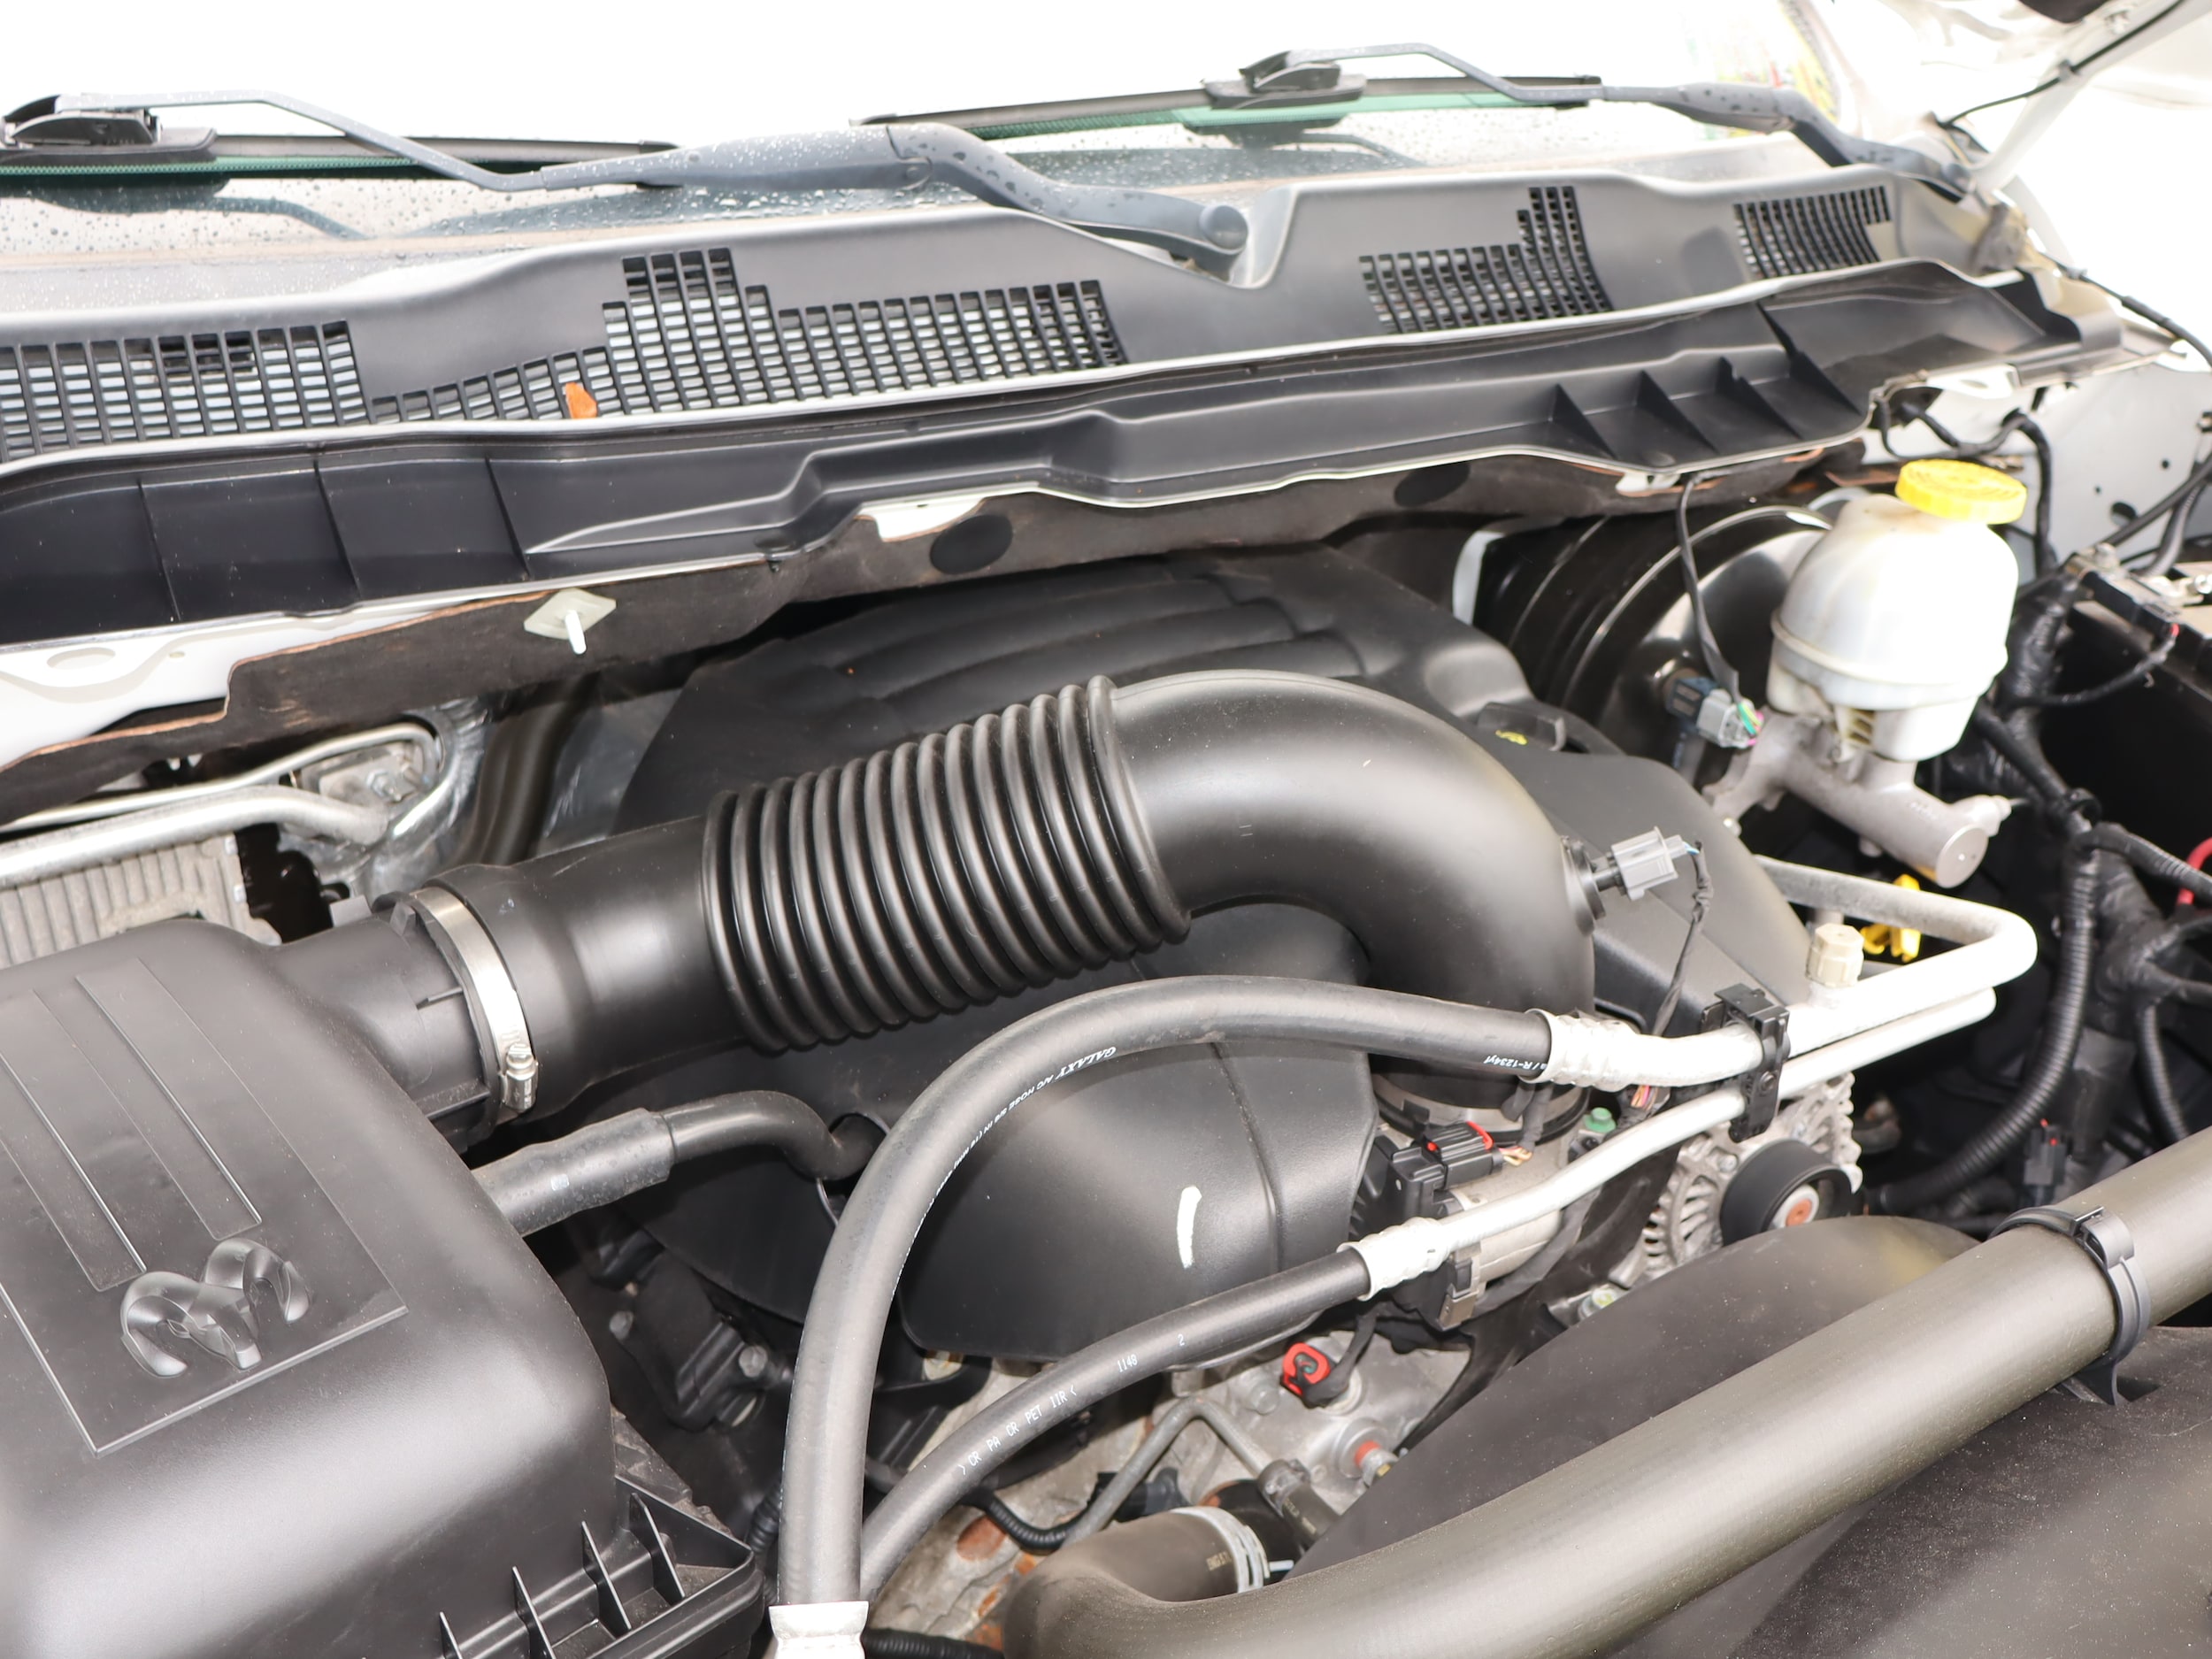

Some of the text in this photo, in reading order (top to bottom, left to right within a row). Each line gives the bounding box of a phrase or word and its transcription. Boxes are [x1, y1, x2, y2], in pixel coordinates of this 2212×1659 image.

[1056, 1046, 1117, 1079] GALAXY
[1484, 1055, 1532, 1070] R-1234yf
[1036, 1074, 1054, 1091] A/C
[1009, 1086, 1035, 1110] HOSE
[983, 1120, 994, 1136] IN
[967, 1451, 982, 1466] CR
[986, 1437, 1001, 1452] PA
[1005, 1422, 1020, 1437] CR
[1025, 1405, 1042, 1425] PET
[1049, 1390, 1068, 1409] IIR
[1117, 1354, 1138, 1372] 1148
[1178, 1333, 1186, 1347] 2
